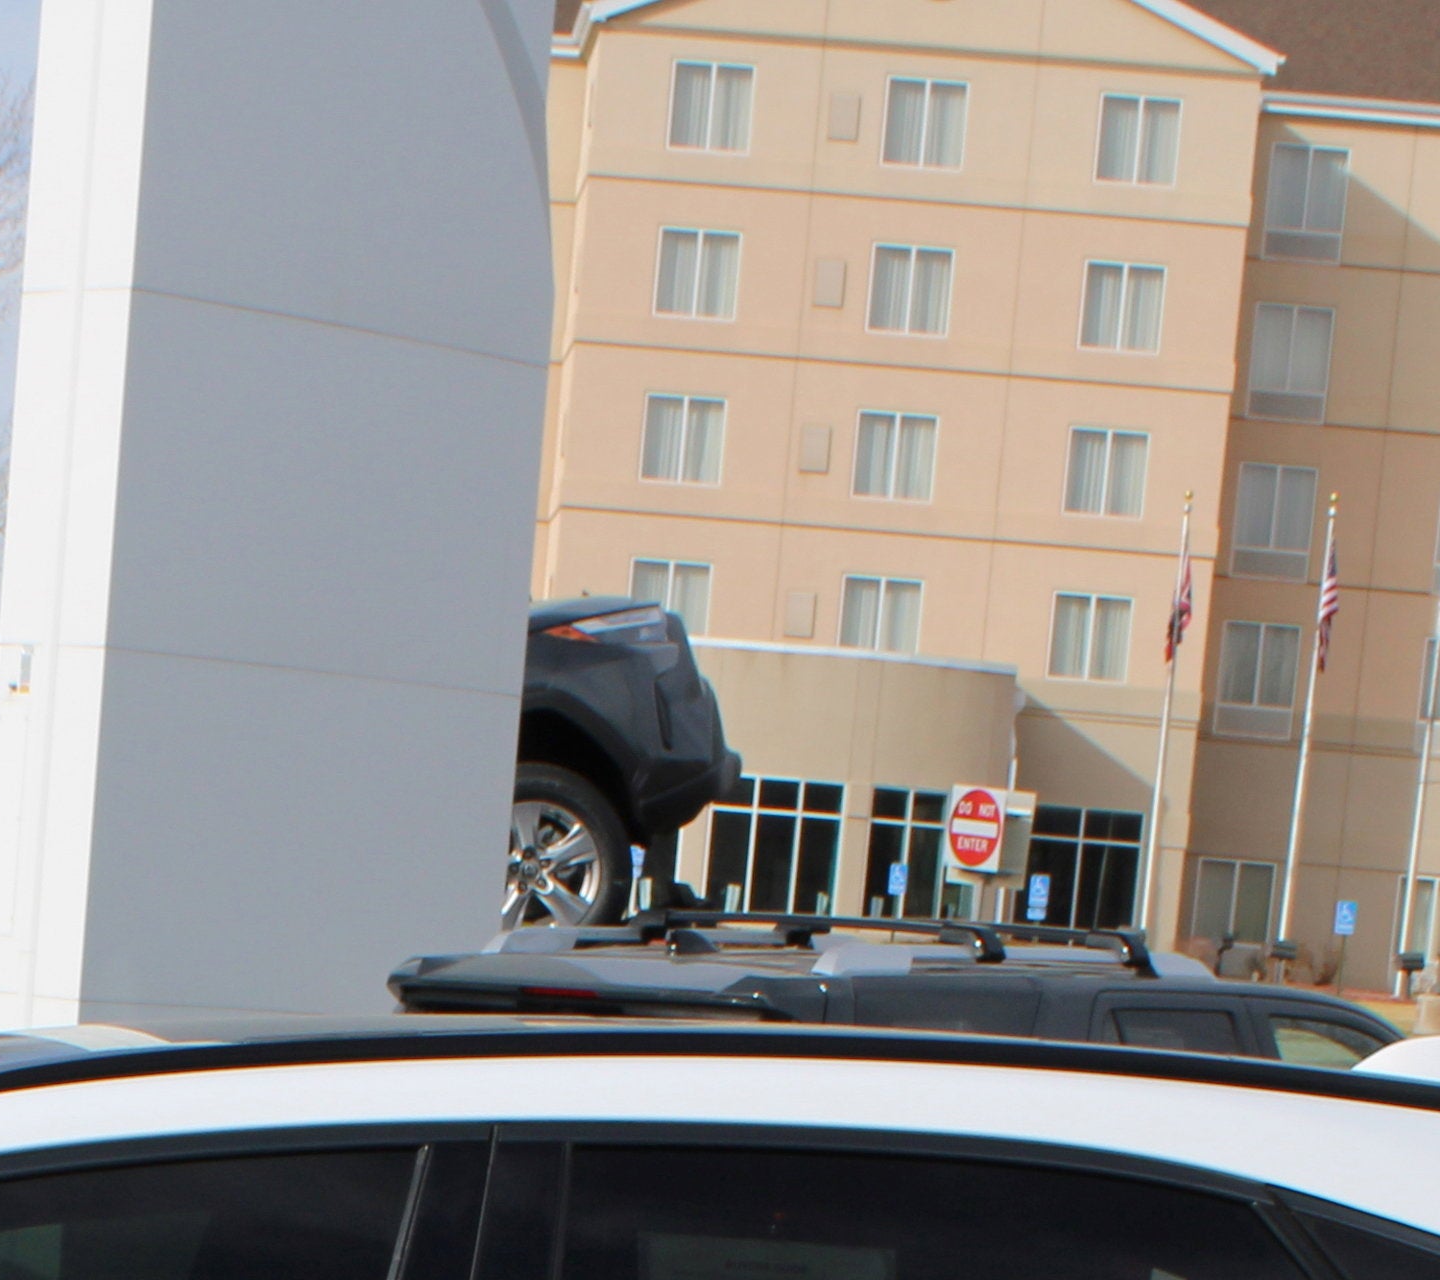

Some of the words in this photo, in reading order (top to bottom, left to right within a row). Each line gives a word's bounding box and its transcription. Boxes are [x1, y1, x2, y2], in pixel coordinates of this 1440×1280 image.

[958, 800, 973, 815] DO
[978, 803, 996, 819] NOT
[957, 836, 988, 853] ENTER
